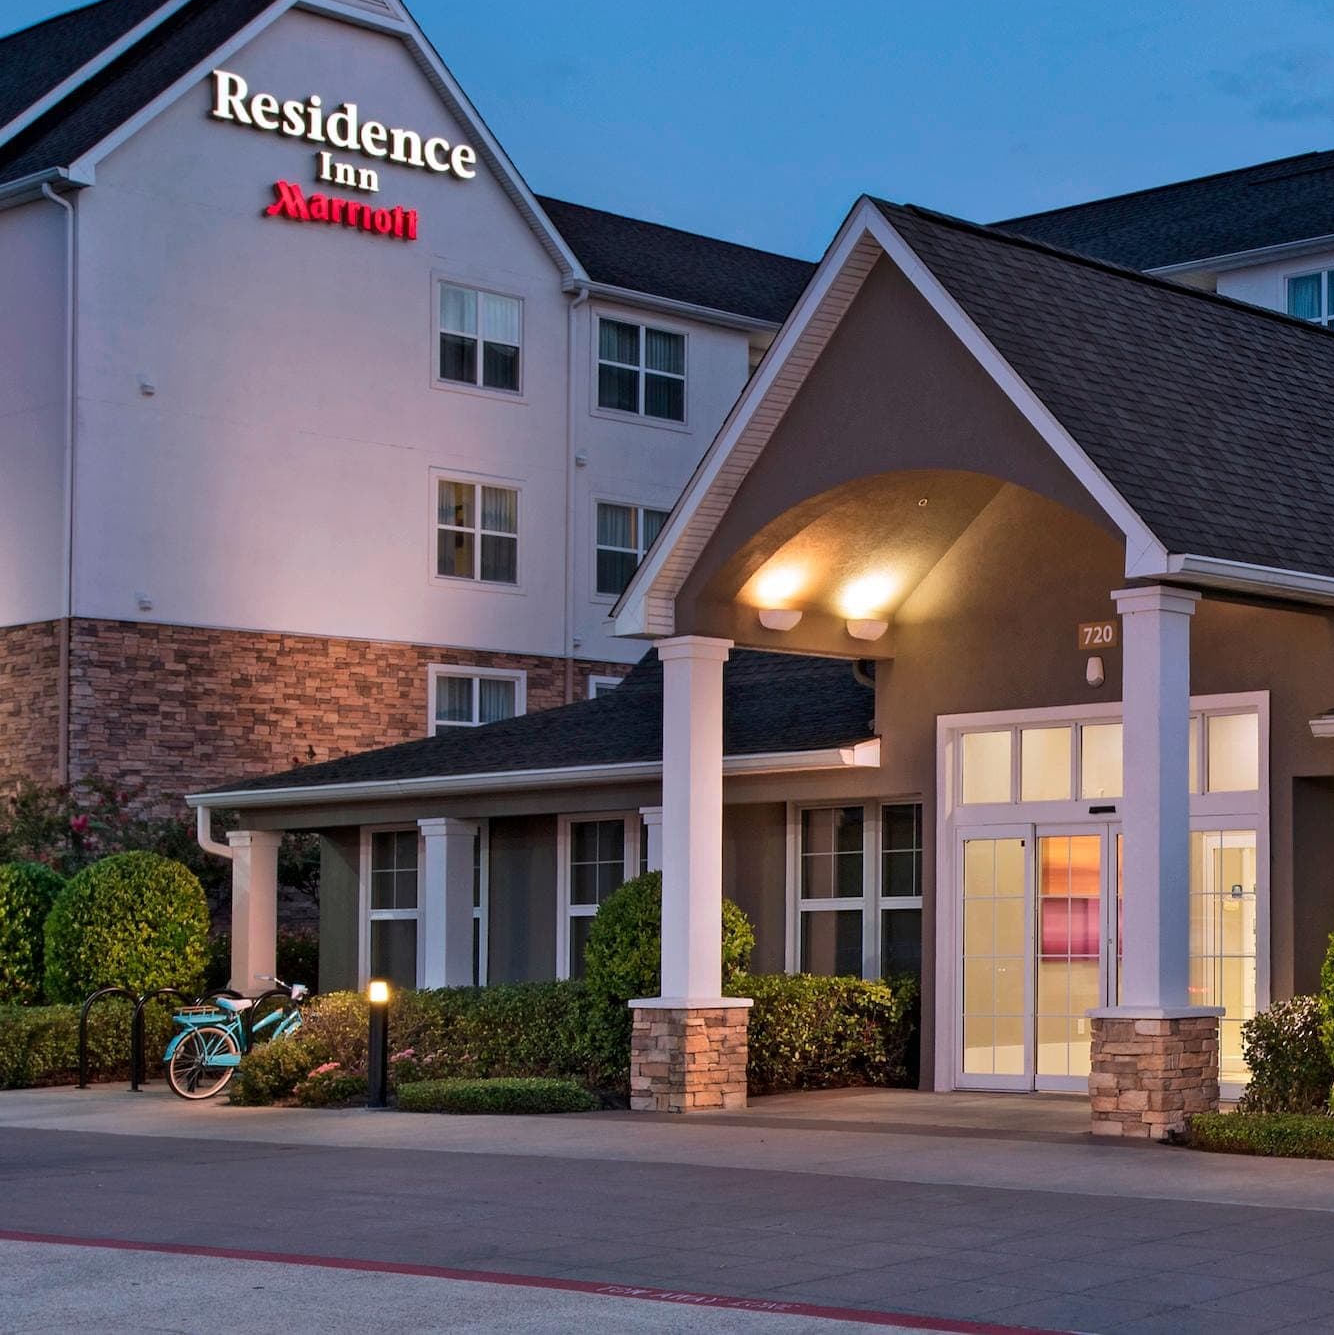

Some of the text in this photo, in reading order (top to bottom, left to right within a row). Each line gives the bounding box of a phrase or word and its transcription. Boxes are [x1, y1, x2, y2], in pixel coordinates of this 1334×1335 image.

[211, 69, 477, 179] Residence
[319, 150, 380, 193] Inn
[265, 179, 418, 241] Marriott
[1083, 625, 1113, 645] 720
